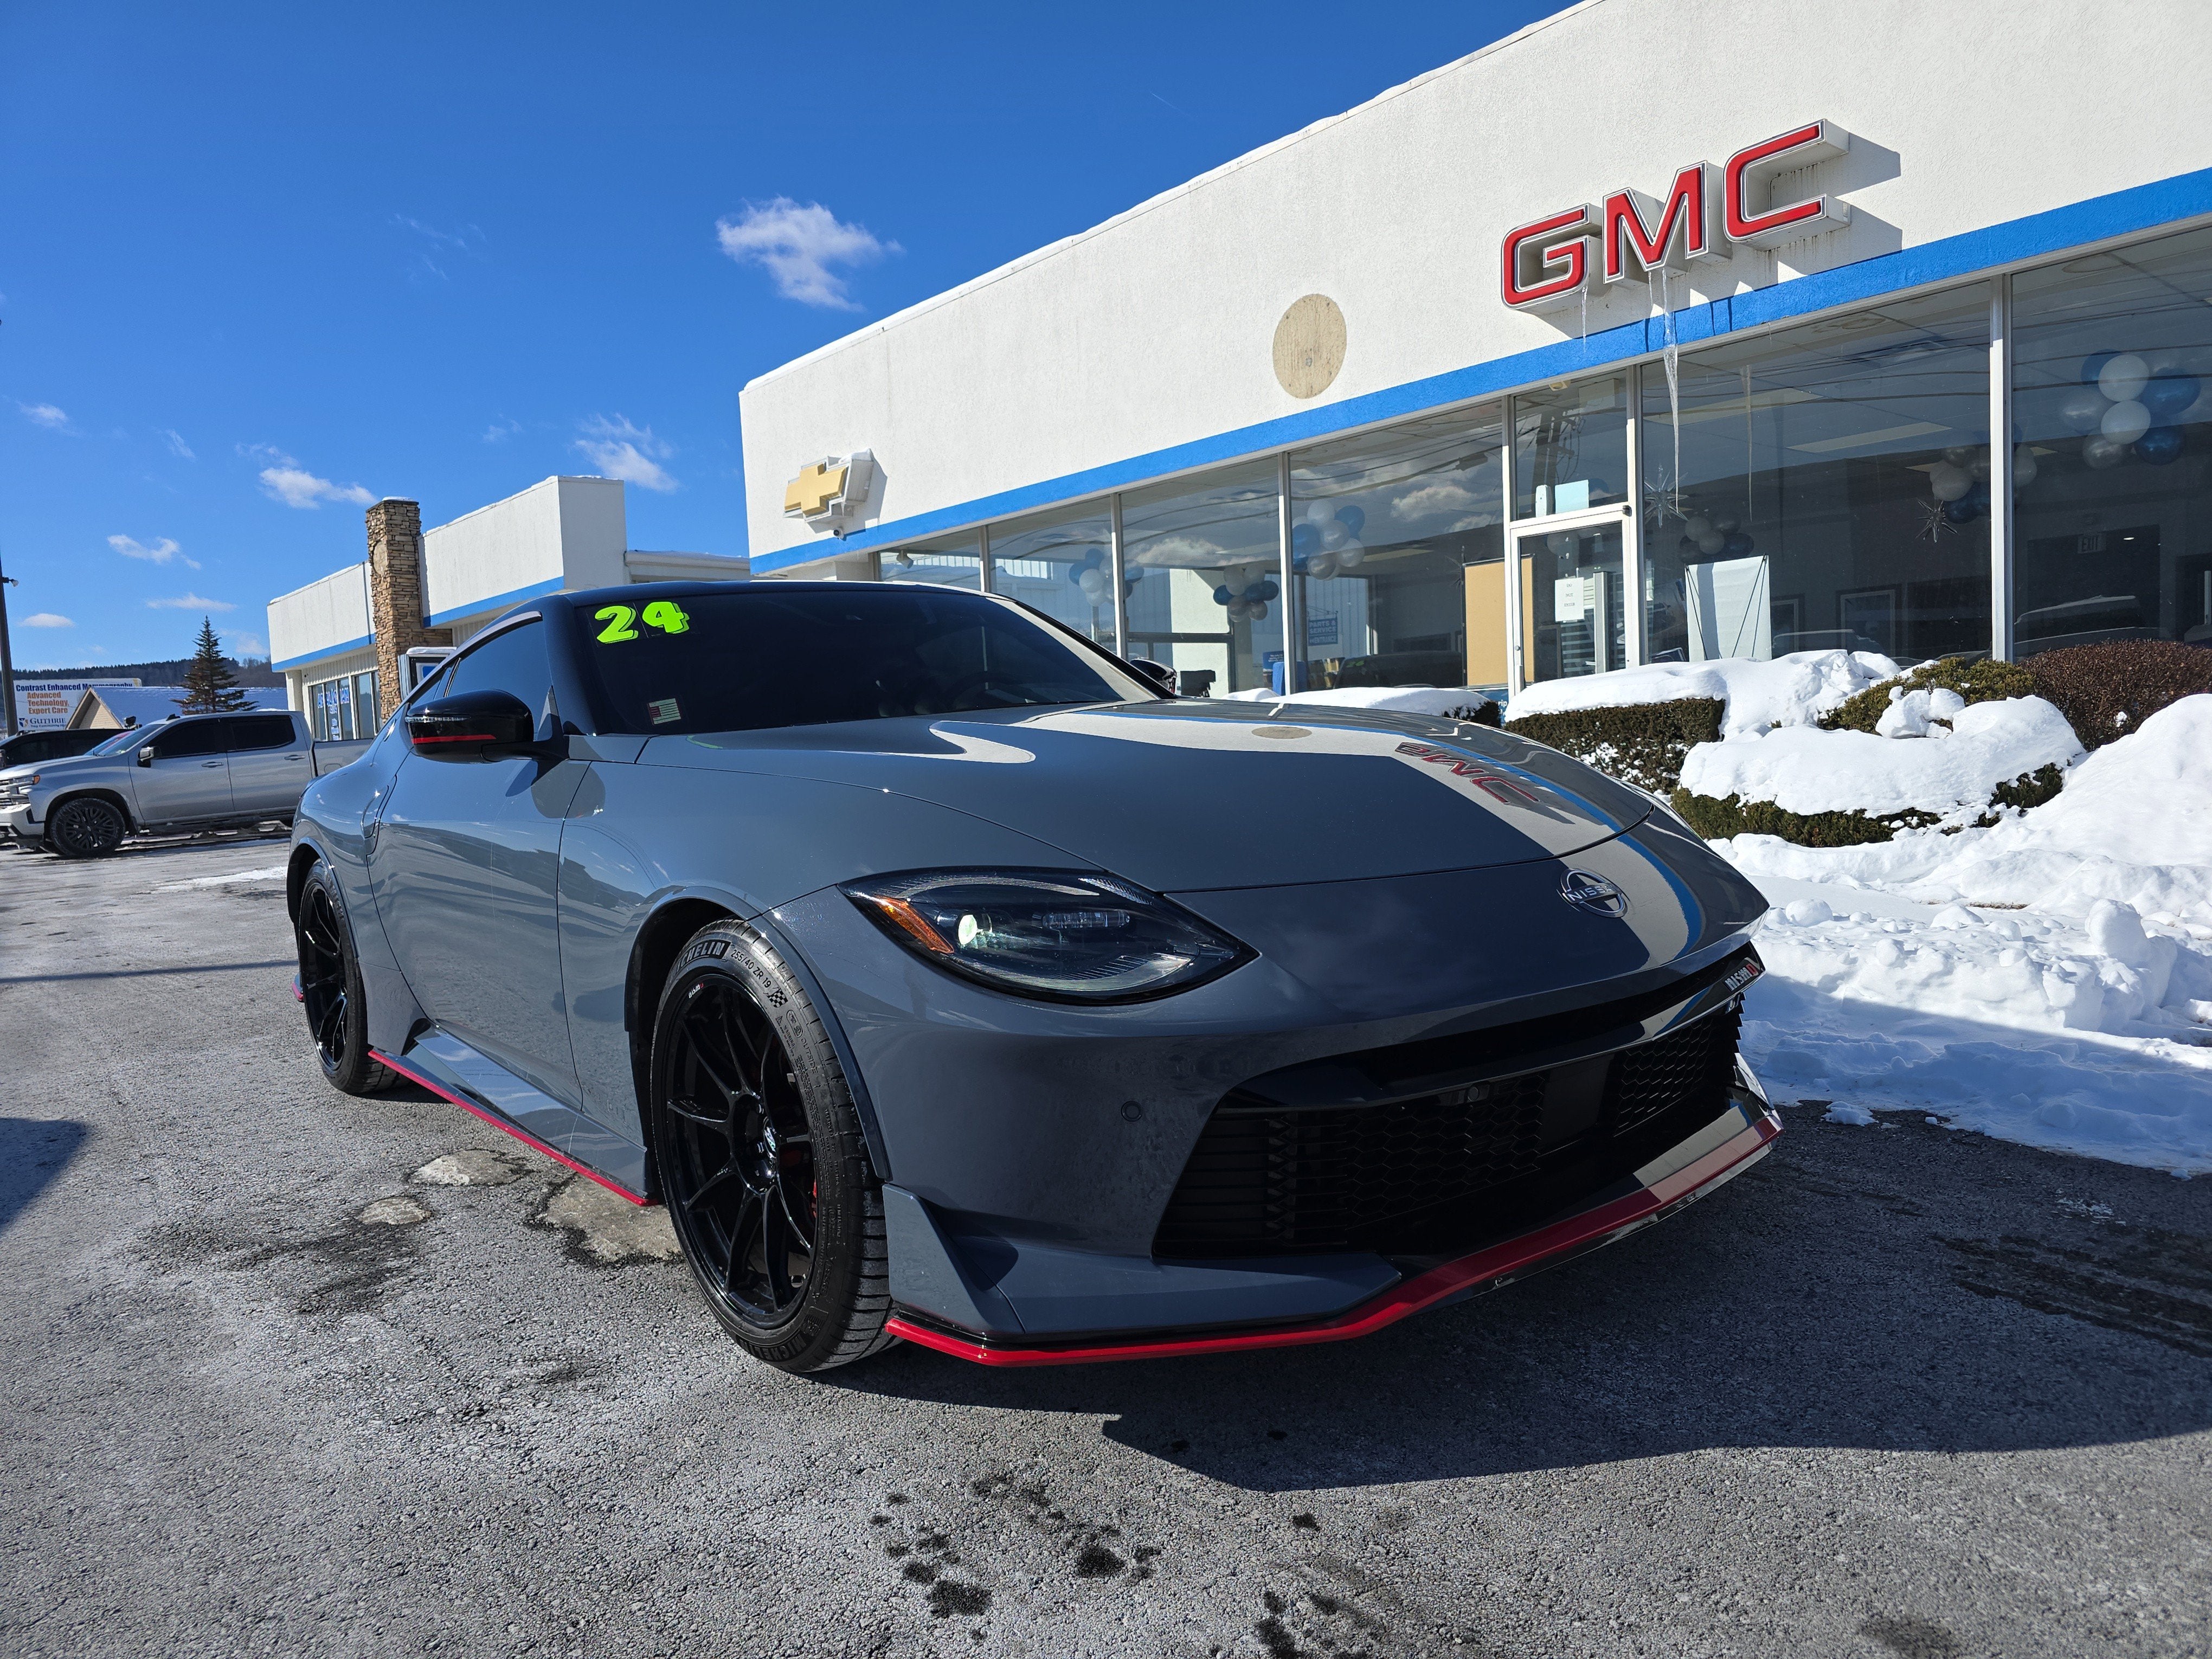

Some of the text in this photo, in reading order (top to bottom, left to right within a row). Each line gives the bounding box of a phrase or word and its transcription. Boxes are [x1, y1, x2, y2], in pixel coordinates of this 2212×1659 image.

[1501, 118, 1827, 310] GMC
[2081, 536, 2098, 551] EXIT
[595, 601, 690, 644] 24
[1567, 885, 1614, 901] NISSA
[677, 942, 725, 972] ICHELIN
[730, 949, 772, 988] 255/40 ZR 19
[801, 1037, 818, 1074] OUTSIDE
